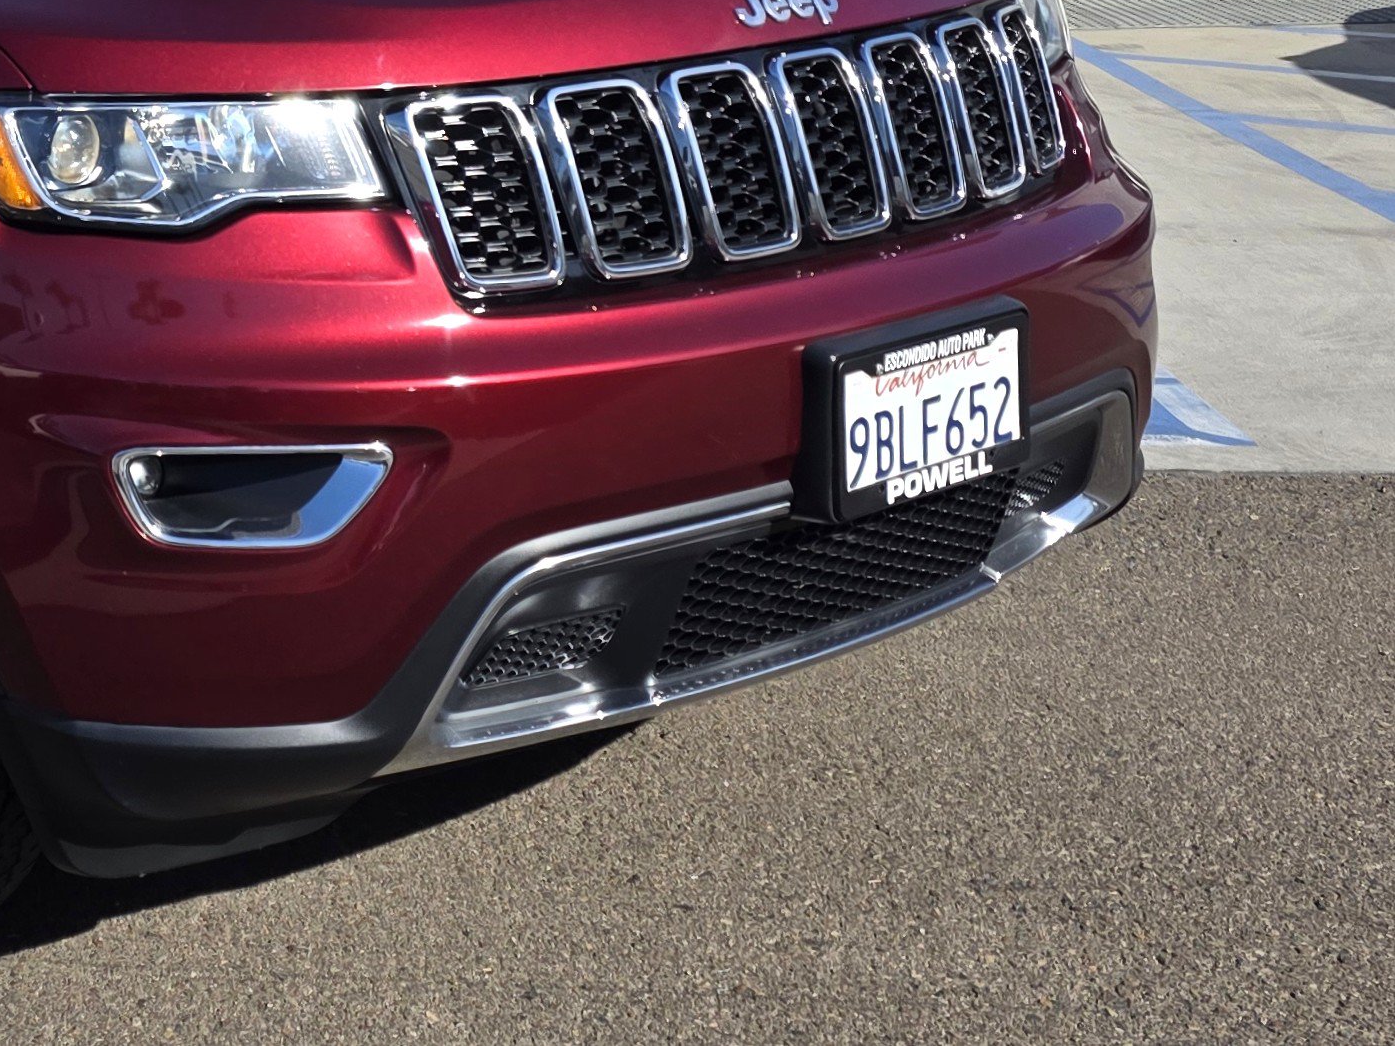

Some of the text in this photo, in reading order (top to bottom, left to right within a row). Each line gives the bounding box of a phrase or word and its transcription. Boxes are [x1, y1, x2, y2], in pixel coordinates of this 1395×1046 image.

[875, 350, 990, 397] California
[884, 327, 986, 373] ESCONDIDO AUTO PARK
[849, 376, 1013, 490] 9BLF652
[885, 450, 994, 505] POWELL
